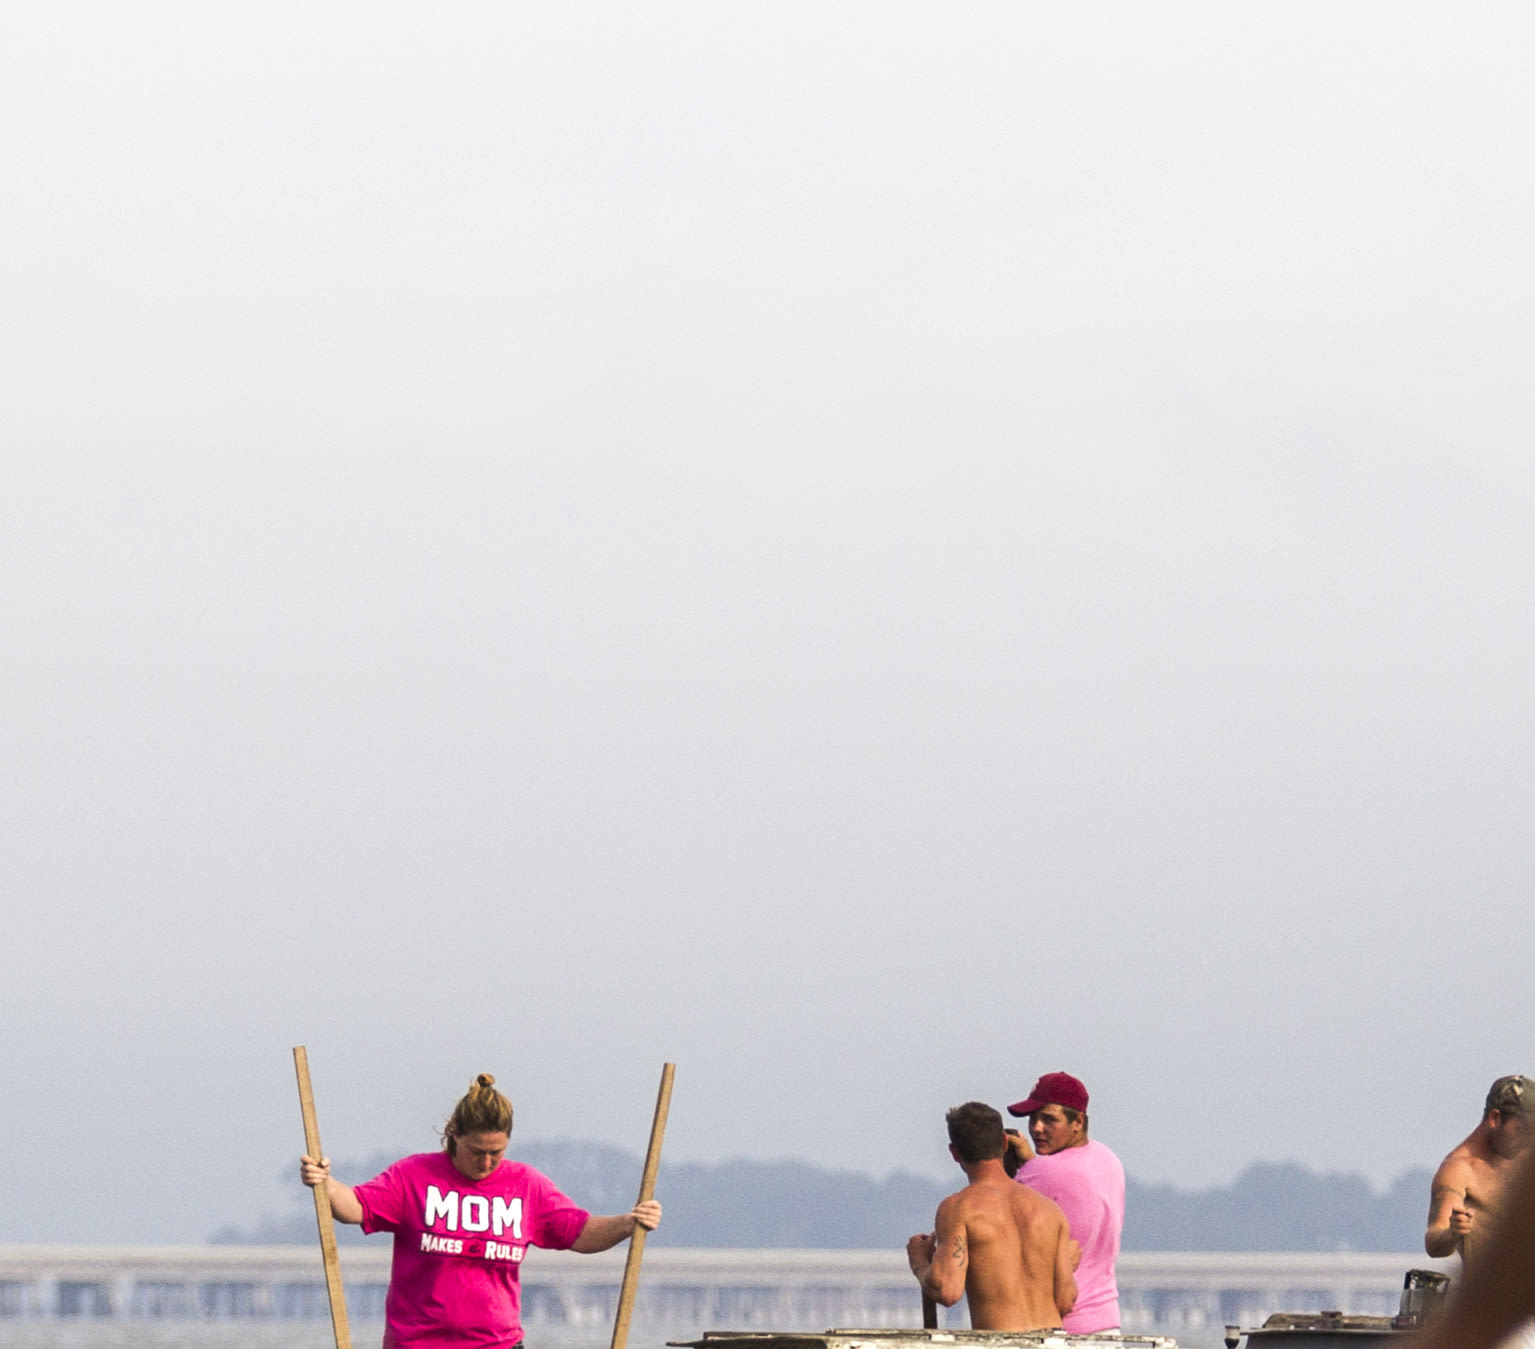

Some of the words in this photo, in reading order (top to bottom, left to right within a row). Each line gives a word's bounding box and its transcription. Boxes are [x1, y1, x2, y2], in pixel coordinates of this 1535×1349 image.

[424, 1184, 523, 1239] MOM
[420, 1232, 463, 1254] MAKES
[484, 1240, 524, 1262] RULES
